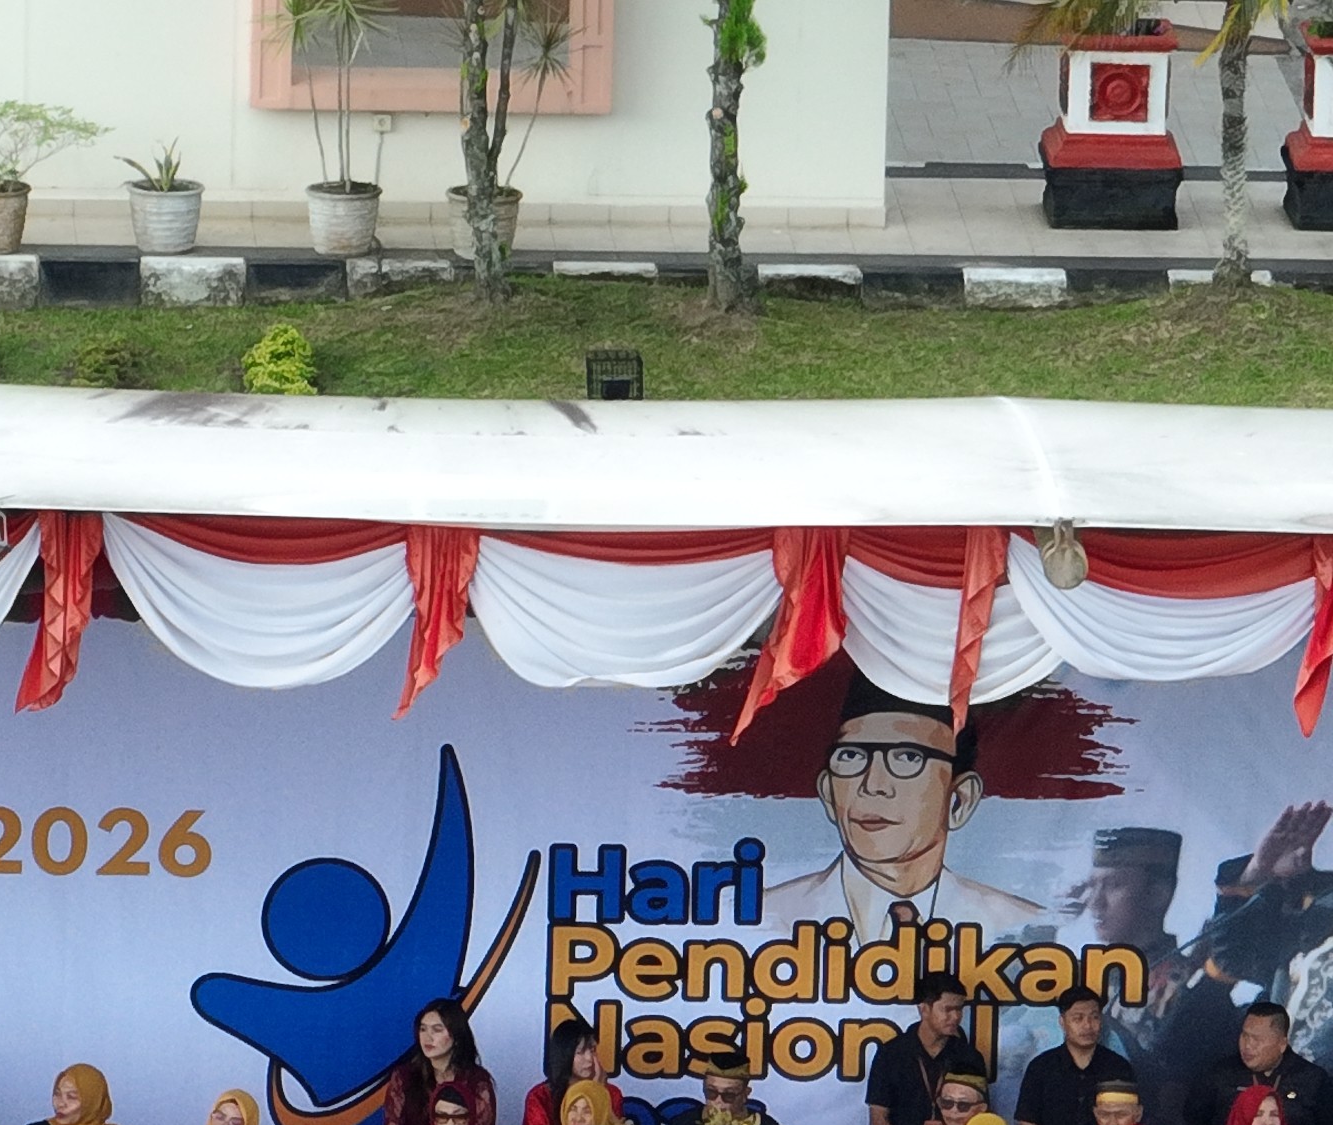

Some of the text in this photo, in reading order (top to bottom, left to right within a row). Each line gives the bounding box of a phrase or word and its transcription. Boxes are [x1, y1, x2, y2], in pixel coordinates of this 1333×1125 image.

[547, 837, 765, 926] Hari
[547, 920, 1149, 1008] Pendidikan
[545, 997, 999, 1083] Nasionl
